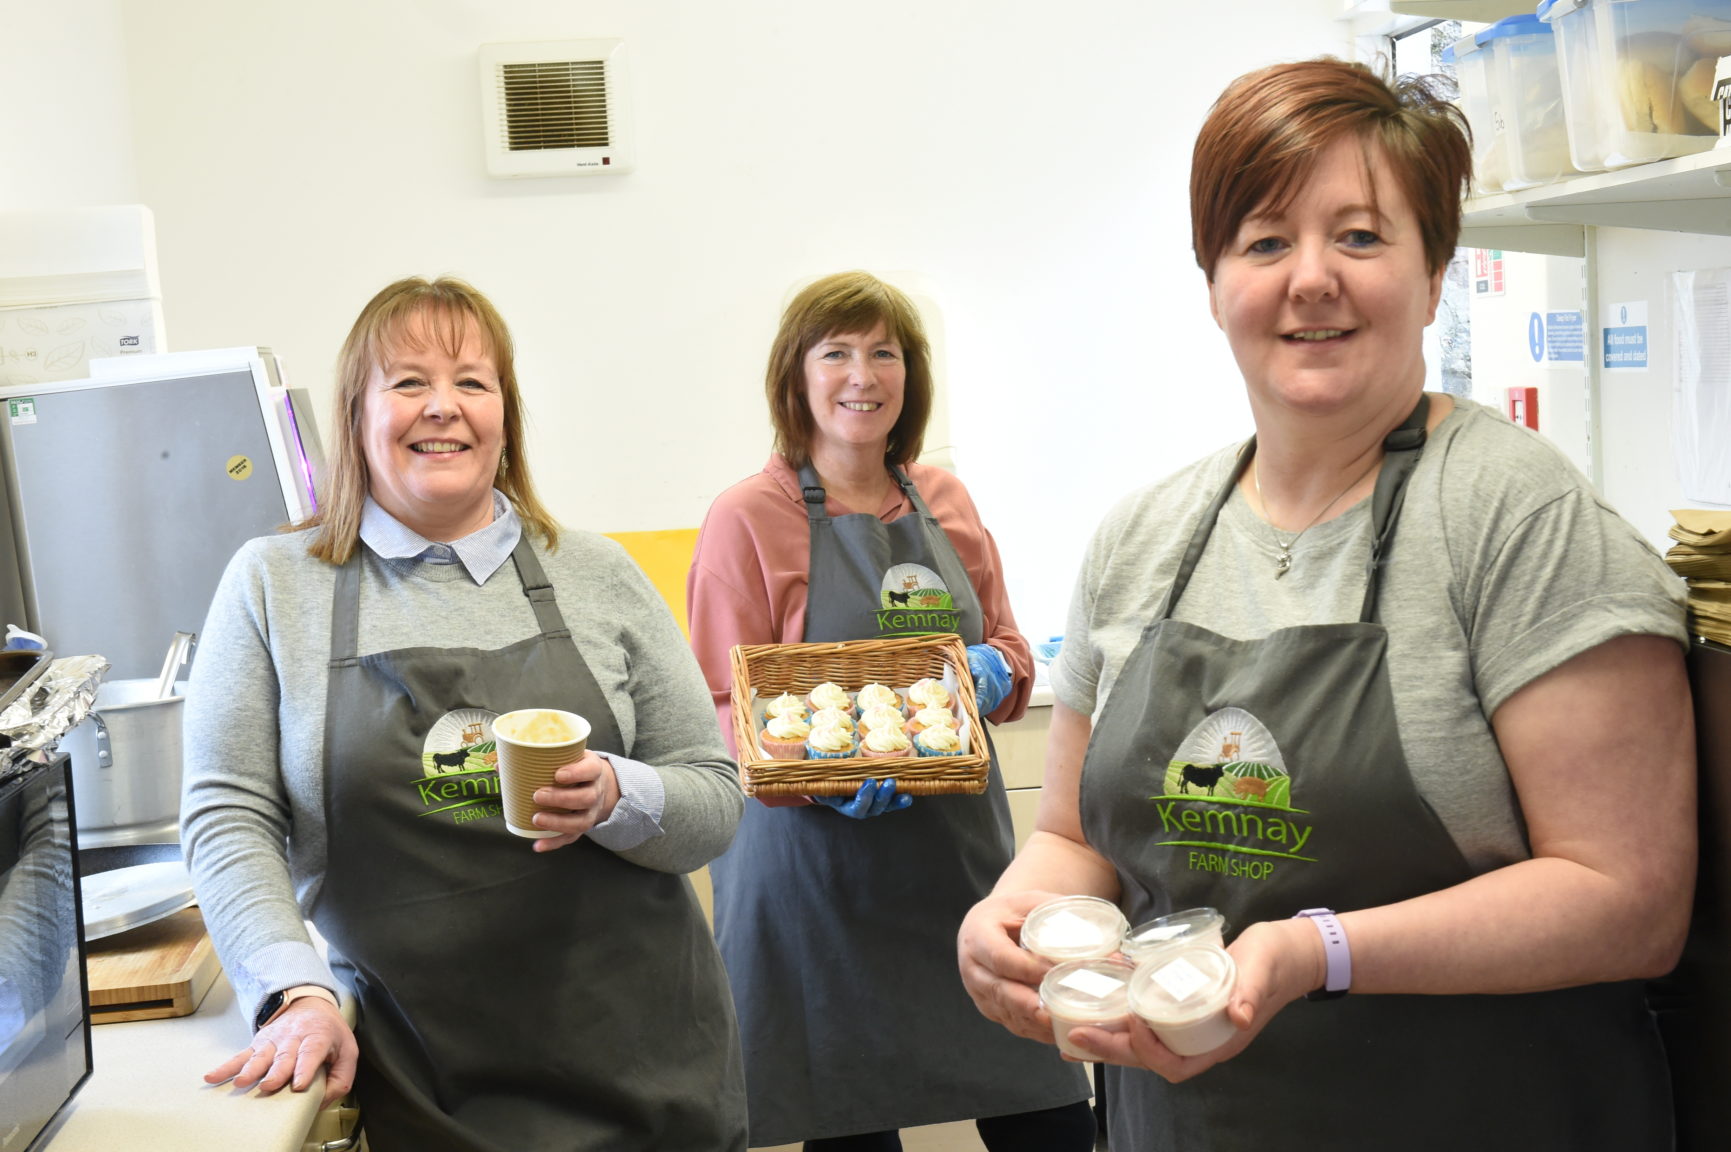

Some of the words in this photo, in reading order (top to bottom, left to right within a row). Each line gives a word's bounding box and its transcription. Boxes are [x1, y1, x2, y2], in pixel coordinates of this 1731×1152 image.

[1614, 333, 1624, 344] food
[1625, 333, 1636, 344] must
[1637, 332, 1643, 344] be
[1605, 350, 1623, 362] covered
[1624, 350, 1632, 361] and
[1633, 350, 1646, 361] dated
[876, 612, 960, 632] Kemnay
[453, 807, 489, 825] FARM
[1156, 801, 1312, 853] Kemnay
[1188, 852, 1229, 875] FARM
[1230, 861, 1274, 881] SHOP
